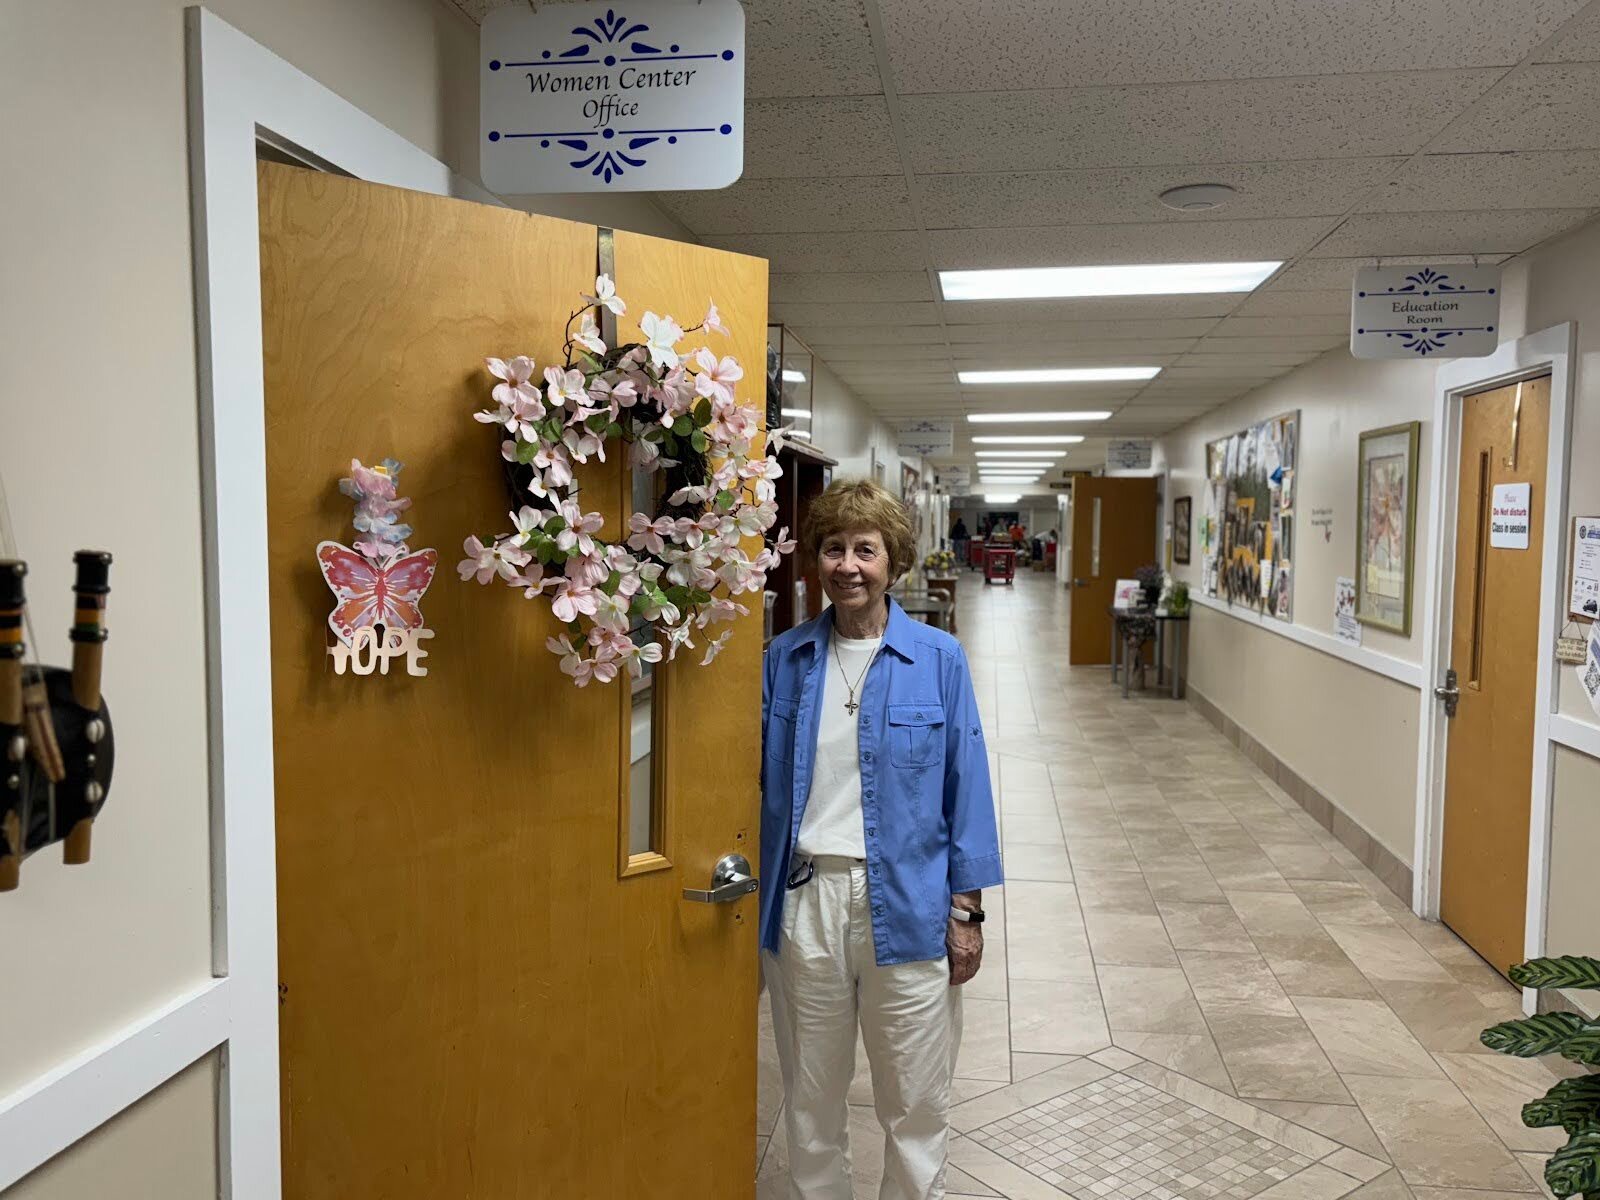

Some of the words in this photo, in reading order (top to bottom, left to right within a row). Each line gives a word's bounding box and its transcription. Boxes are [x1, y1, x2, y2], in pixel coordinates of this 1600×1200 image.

[526, 72, 610, 93] Women
[619, 67, 696, 90] Center
[582, 93, 639, 128] Office
[1392, 300, 1459, 313] Education
[1407, 315, 1443, 324] Room
[1493, 508, 1499, 516] Do
[1500, 508, 1509, 516] Not
[1509, 508, 1527, 517] disturb
[1492, 522, 1504, 533] Class
[1504, 522, 1509, 533] in
[1509, 522, 1527, 534] session
